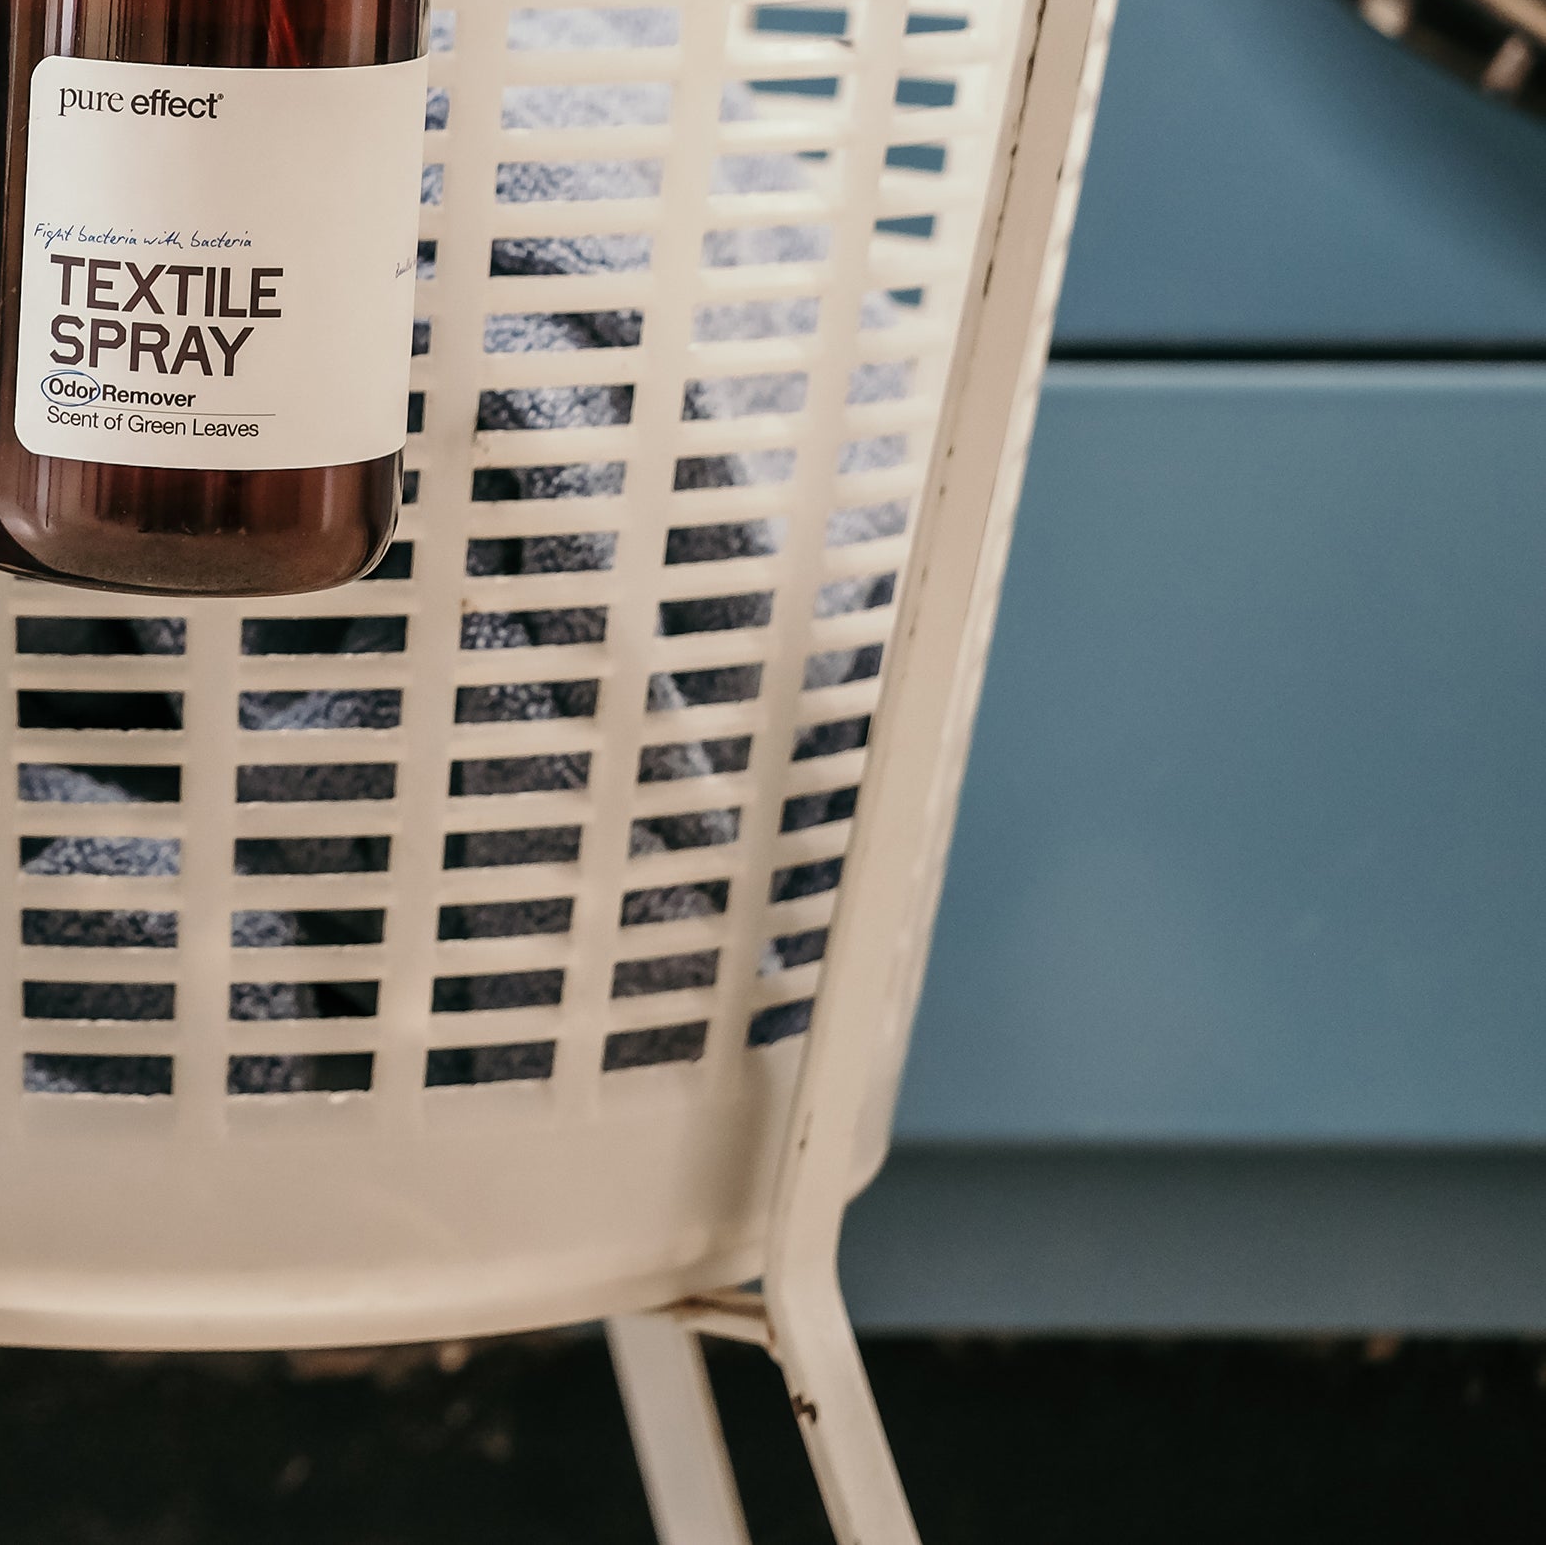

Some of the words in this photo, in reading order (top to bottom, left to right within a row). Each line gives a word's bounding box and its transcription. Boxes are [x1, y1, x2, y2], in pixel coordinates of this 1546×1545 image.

[58, 87, 124, 117] pure
[33, 223, 75, 250] Fight
[77, 225, 137, 246] bacteria
[143, 230, 184, 250] with
[190, 230, 253, 249] bacteria
[50, 253, 284, 318] TEXTILE
[49, 314, 255, 377] SPRAY
[48, 377, 98, 400] Odor
[102, 384, 197, 408] Remover
[47, 405, 100, 429] Scent
[103, 413, 124, 431] of
[128, 414, 187, 436] Green
[192, 419, 260, 438] Leaves
